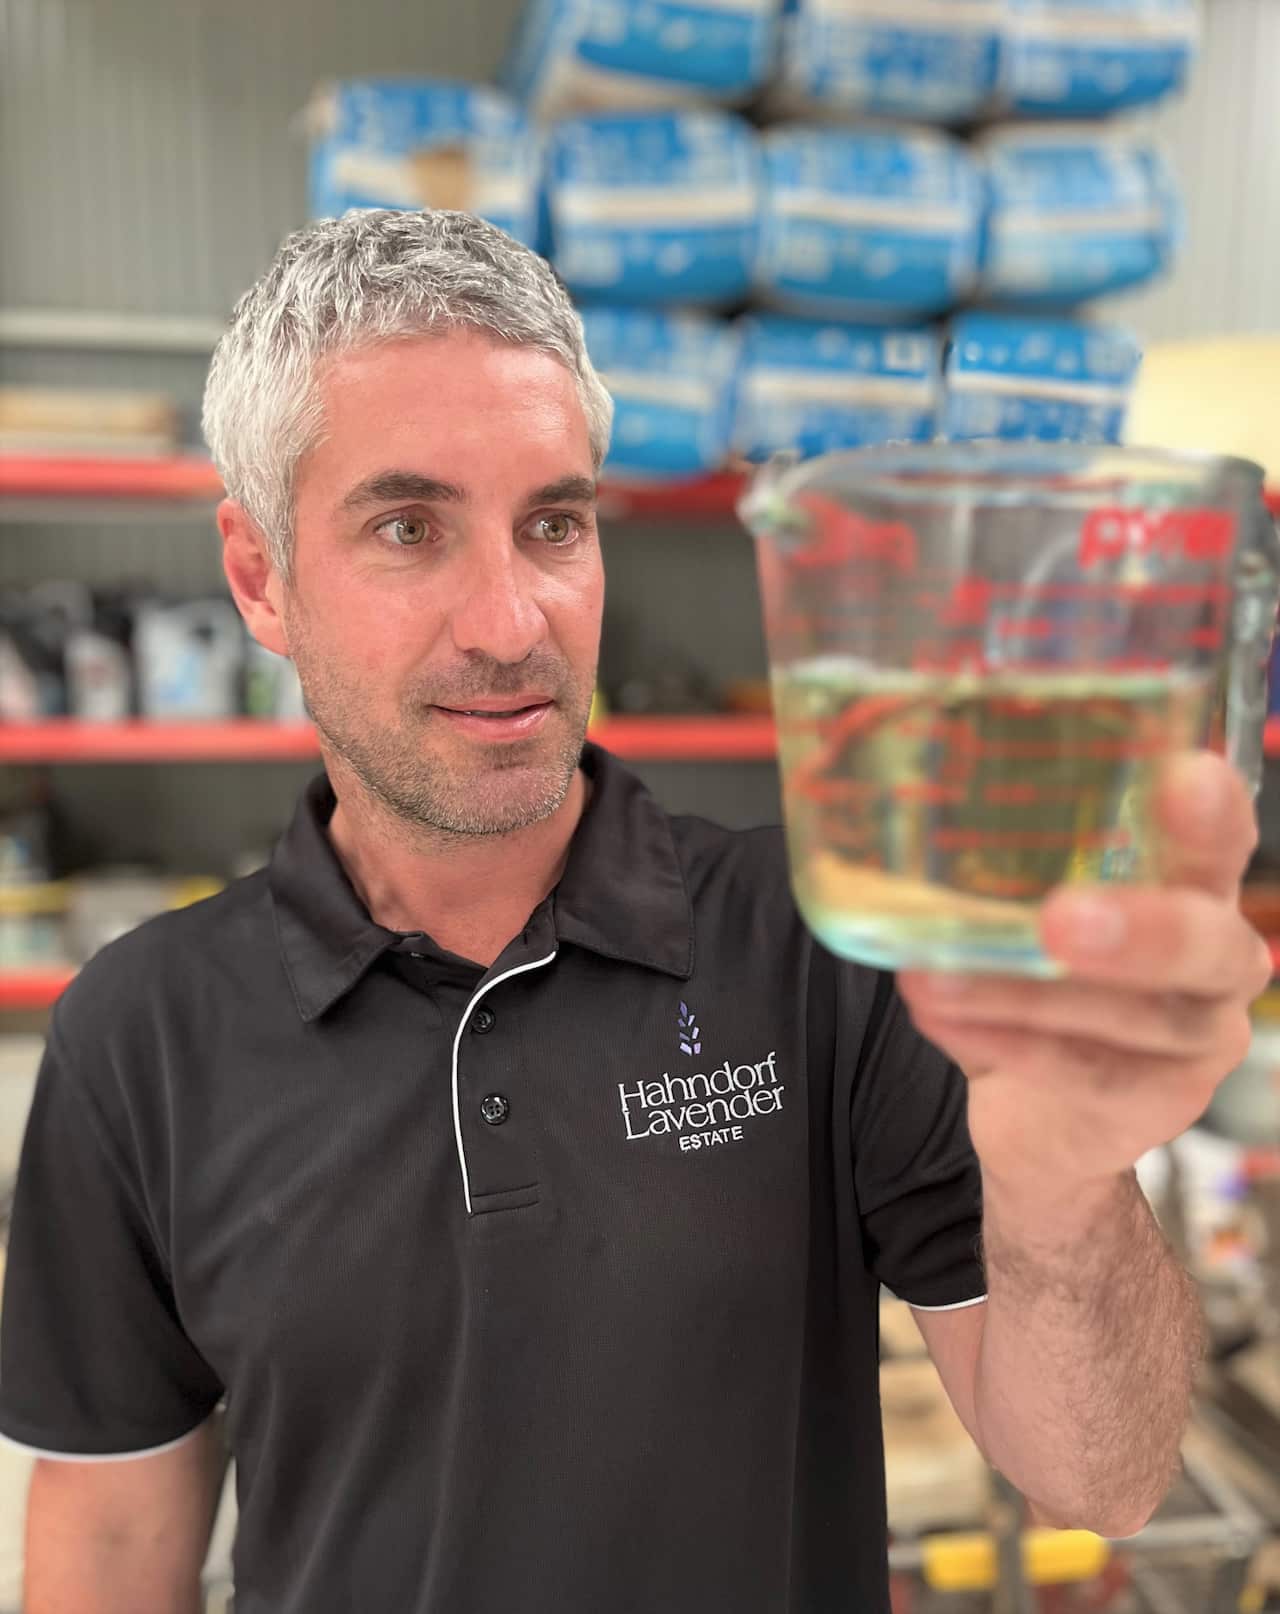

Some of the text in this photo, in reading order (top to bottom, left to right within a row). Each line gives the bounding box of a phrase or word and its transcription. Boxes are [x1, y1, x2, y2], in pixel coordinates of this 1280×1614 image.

[618, 1051, 777, 1112] Hahndorf
[622, 1085, 785, 1140] Lavender
[679, 1125, 744, 1152] ESTATE
